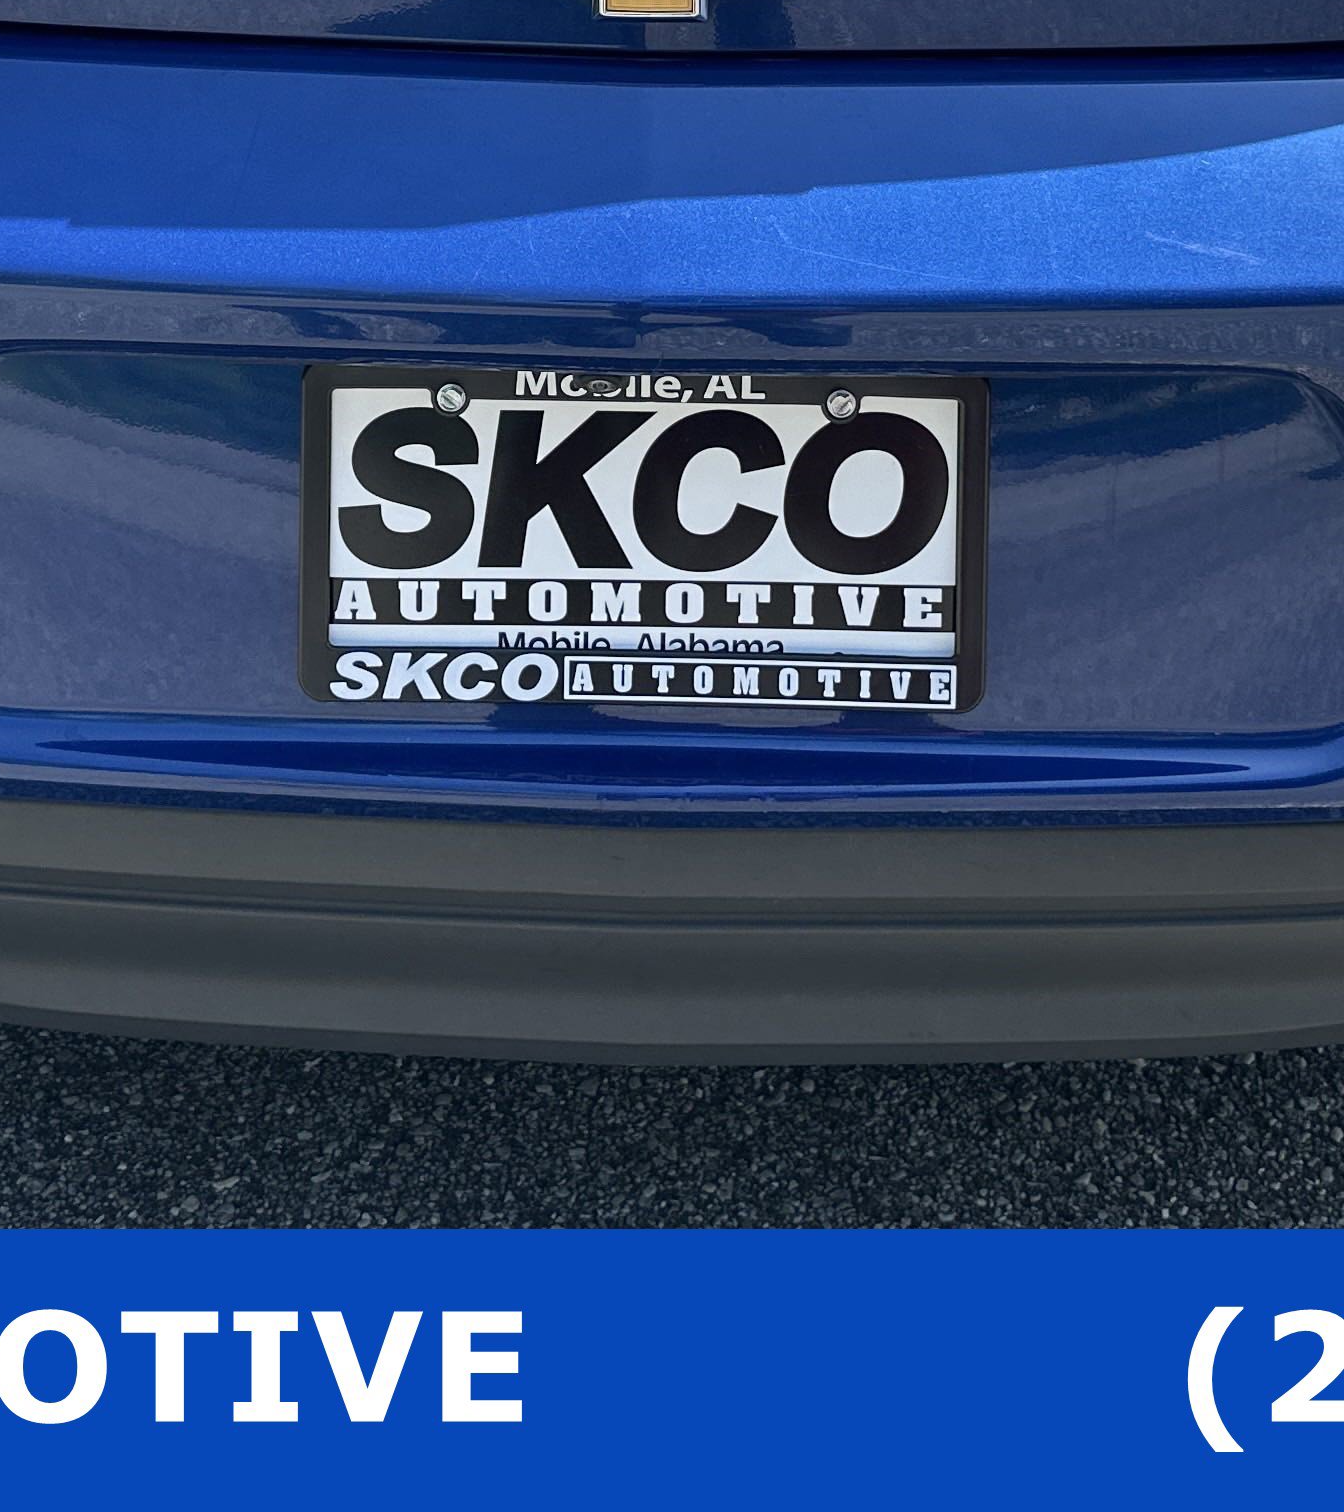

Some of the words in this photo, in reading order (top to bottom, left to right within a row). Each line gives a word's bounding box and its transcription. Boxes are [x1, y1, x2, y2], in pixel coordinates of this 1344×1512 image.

[703, 374, 766, 400] AL
[338, 407, 950, 575] SKCO
[335, 579, 945, 629] AUTOMOTIVE
[636, 632, 785, 654] Alabama
[329, 652, 559, 701] SKCO
[572, 663, 952, 703] AUTOMOTIVE
